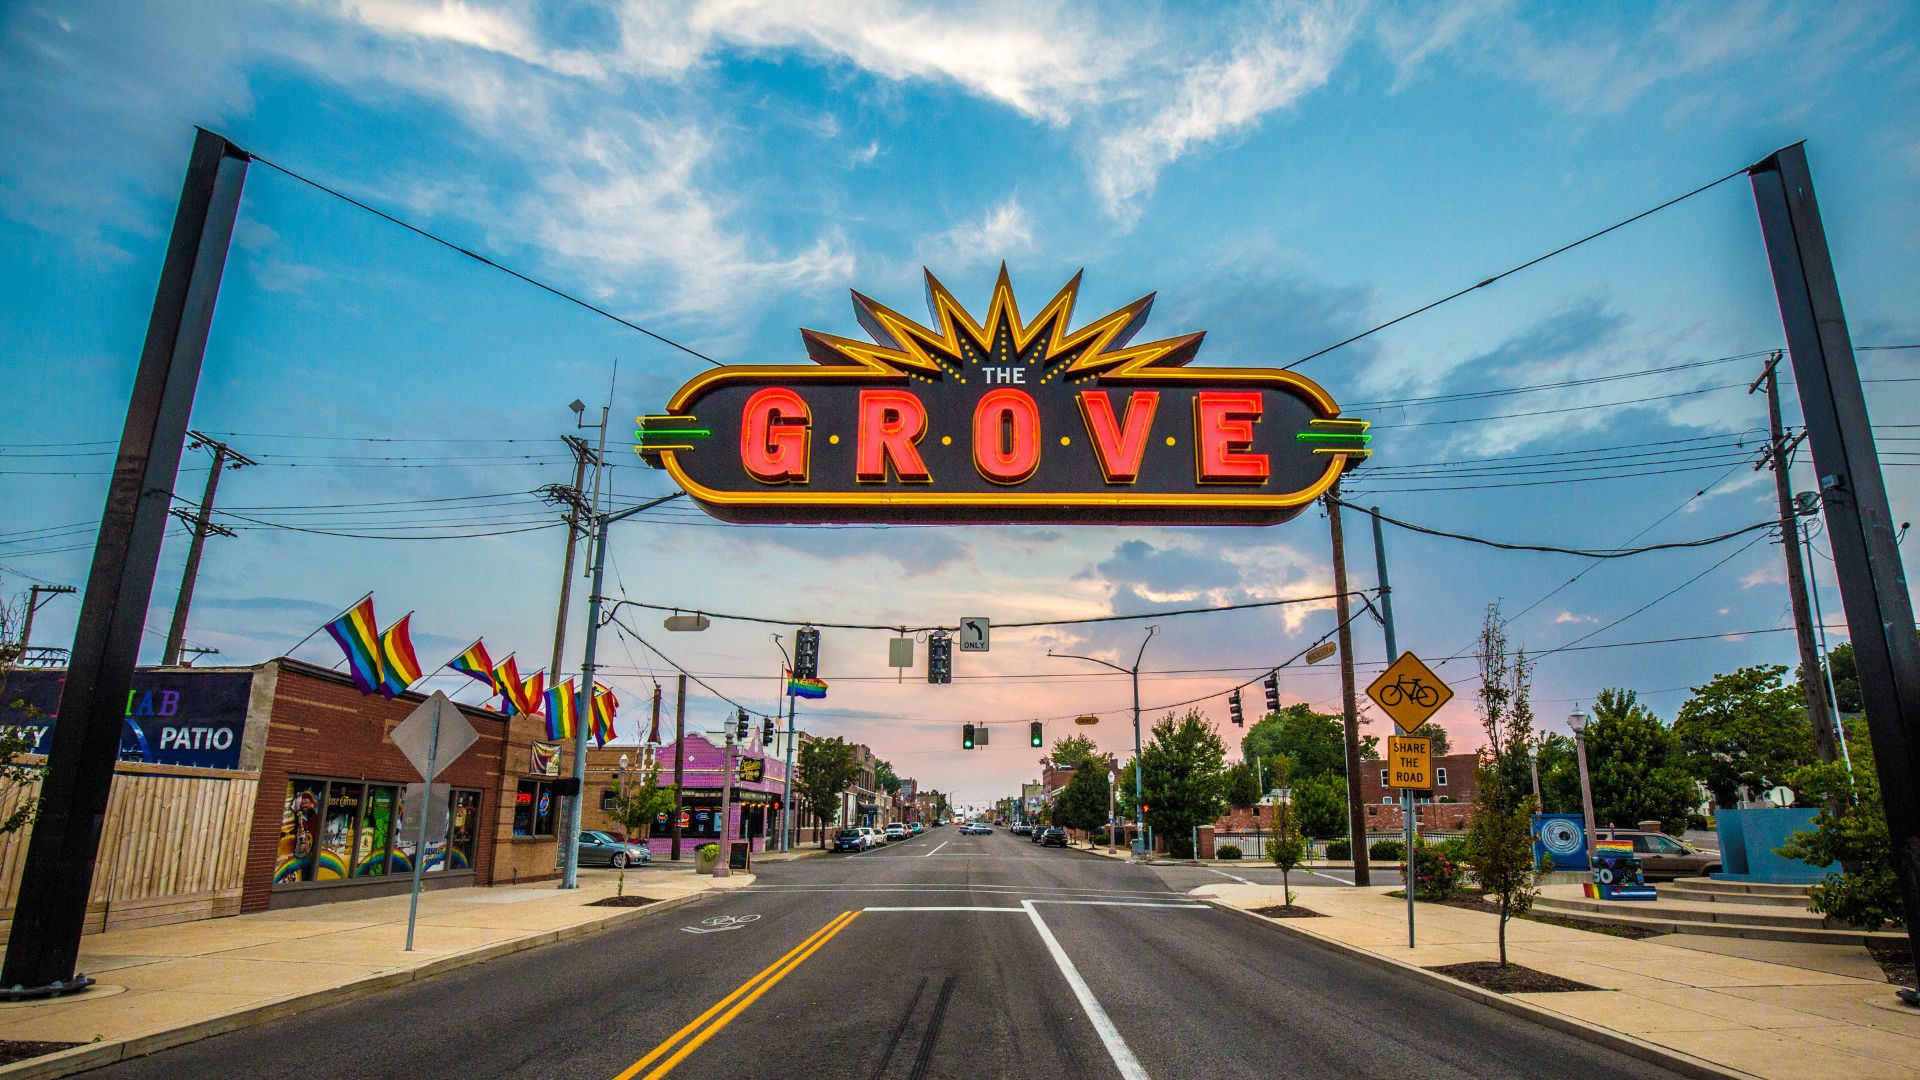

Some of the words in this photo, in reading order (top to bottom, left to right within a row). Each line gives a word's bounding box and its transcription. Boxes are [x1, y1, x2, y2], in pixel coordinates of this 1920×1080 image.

[982, 367, 1026, 384] THE
[740, 387, 1271, 484] GROVE
[964, 641, 985, 649] ONLY
[160, 727, 233, 750] PATIO
[1393, 743, 1426, 754] SHARE
[1400, 757, 1419, 768] THE
[1396, 772, 1423, 783] ROAD
[1592, 867, 1613, 884] 50
